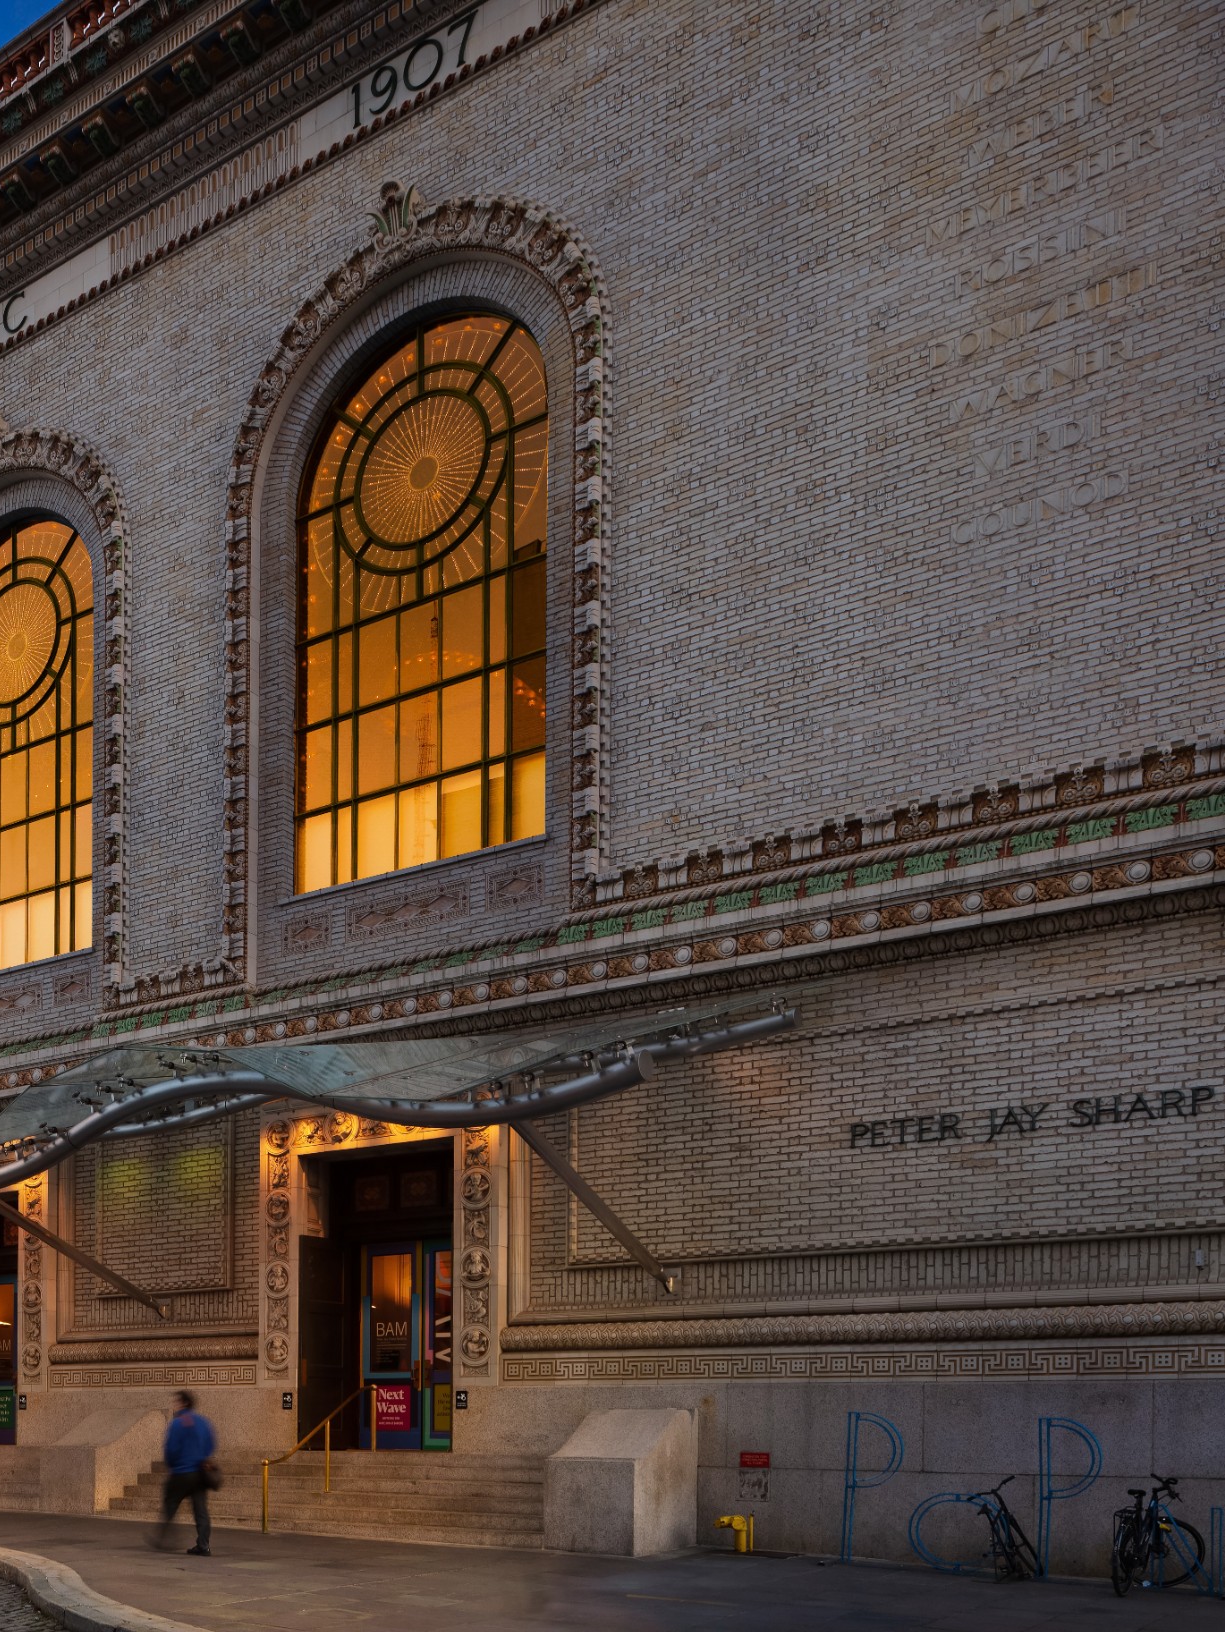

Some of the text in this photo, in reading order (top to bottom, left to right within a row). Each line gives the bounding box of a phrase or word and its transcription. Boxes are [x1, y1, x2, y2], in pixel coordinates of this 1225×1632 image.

[351, 9, 479, 130] 1907
[849, 1084, 1216, 1149] PETER JAY SHARP
[376, 1321, 408, 1337] BAM
[378, 1388, 405, 1400] Next
[376, 1402, 407, 1413] Wave
